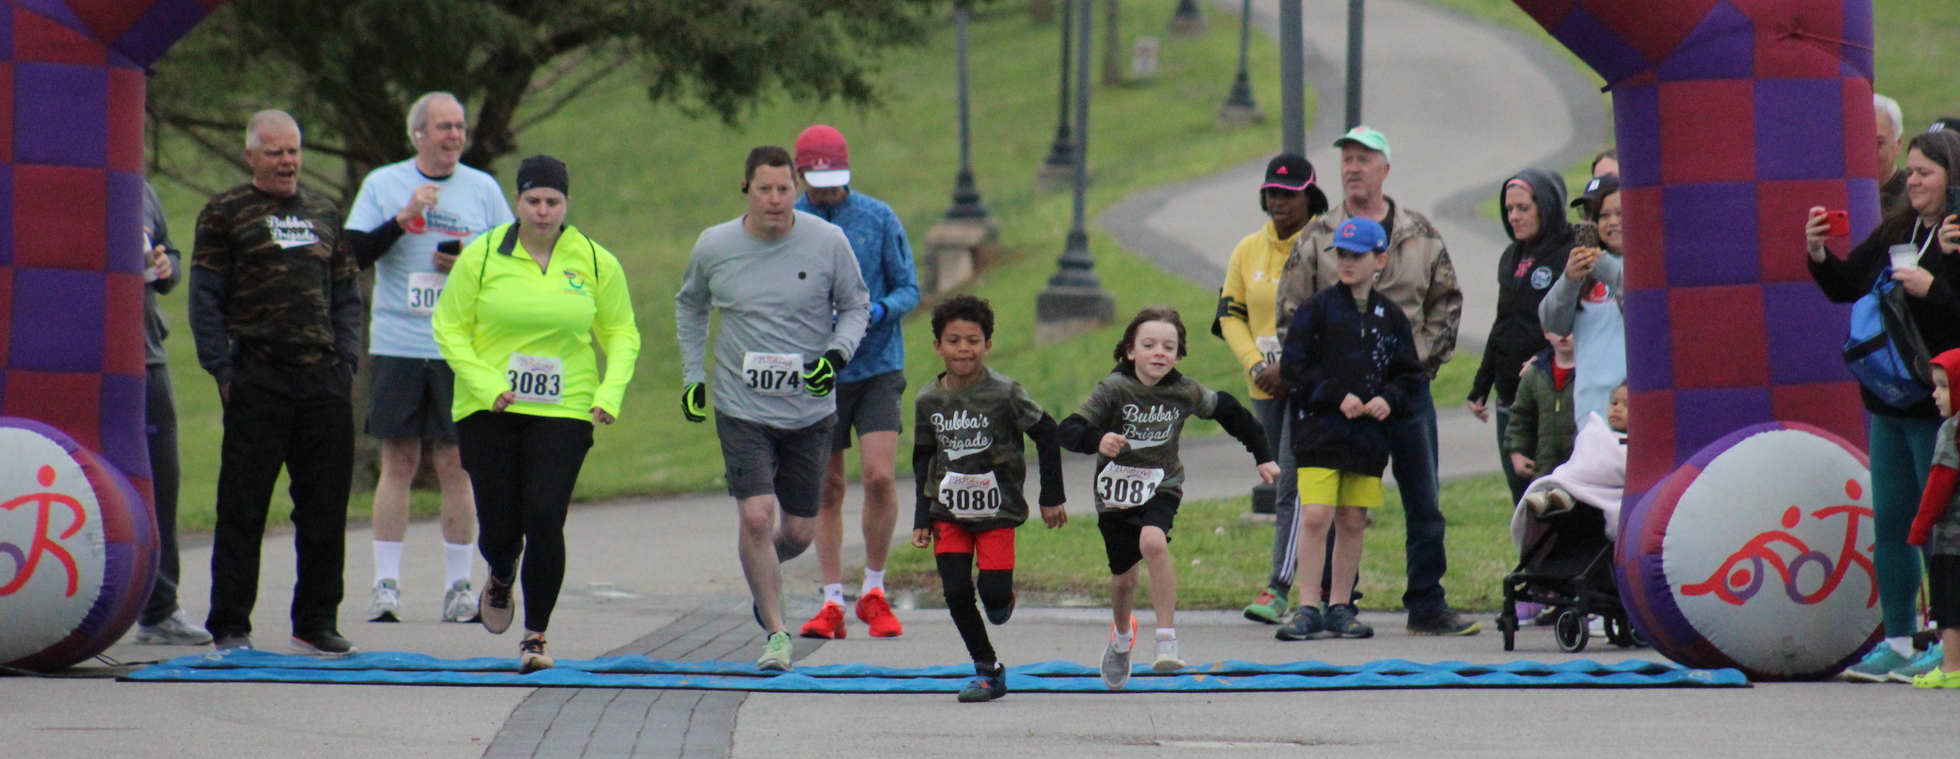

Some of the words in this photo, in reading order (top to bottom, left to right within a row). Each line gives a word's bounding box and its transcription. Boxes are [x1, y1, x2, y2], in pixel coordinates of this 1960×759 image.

[1342, 224, 1356, 237] C
[411, 288, 443, 308] 30
[508, 370, 560, 396] 3083
[746, 369, 800, 390] 3074
[931, 410, 989, 432] Bubba's
[1122, 404, 1179, 424] Bubba's
[936, 431, 989, 450] Brigade
[1122, 423, 1175, 441] Brigad
[941, 487, 1000, 510] 3080
